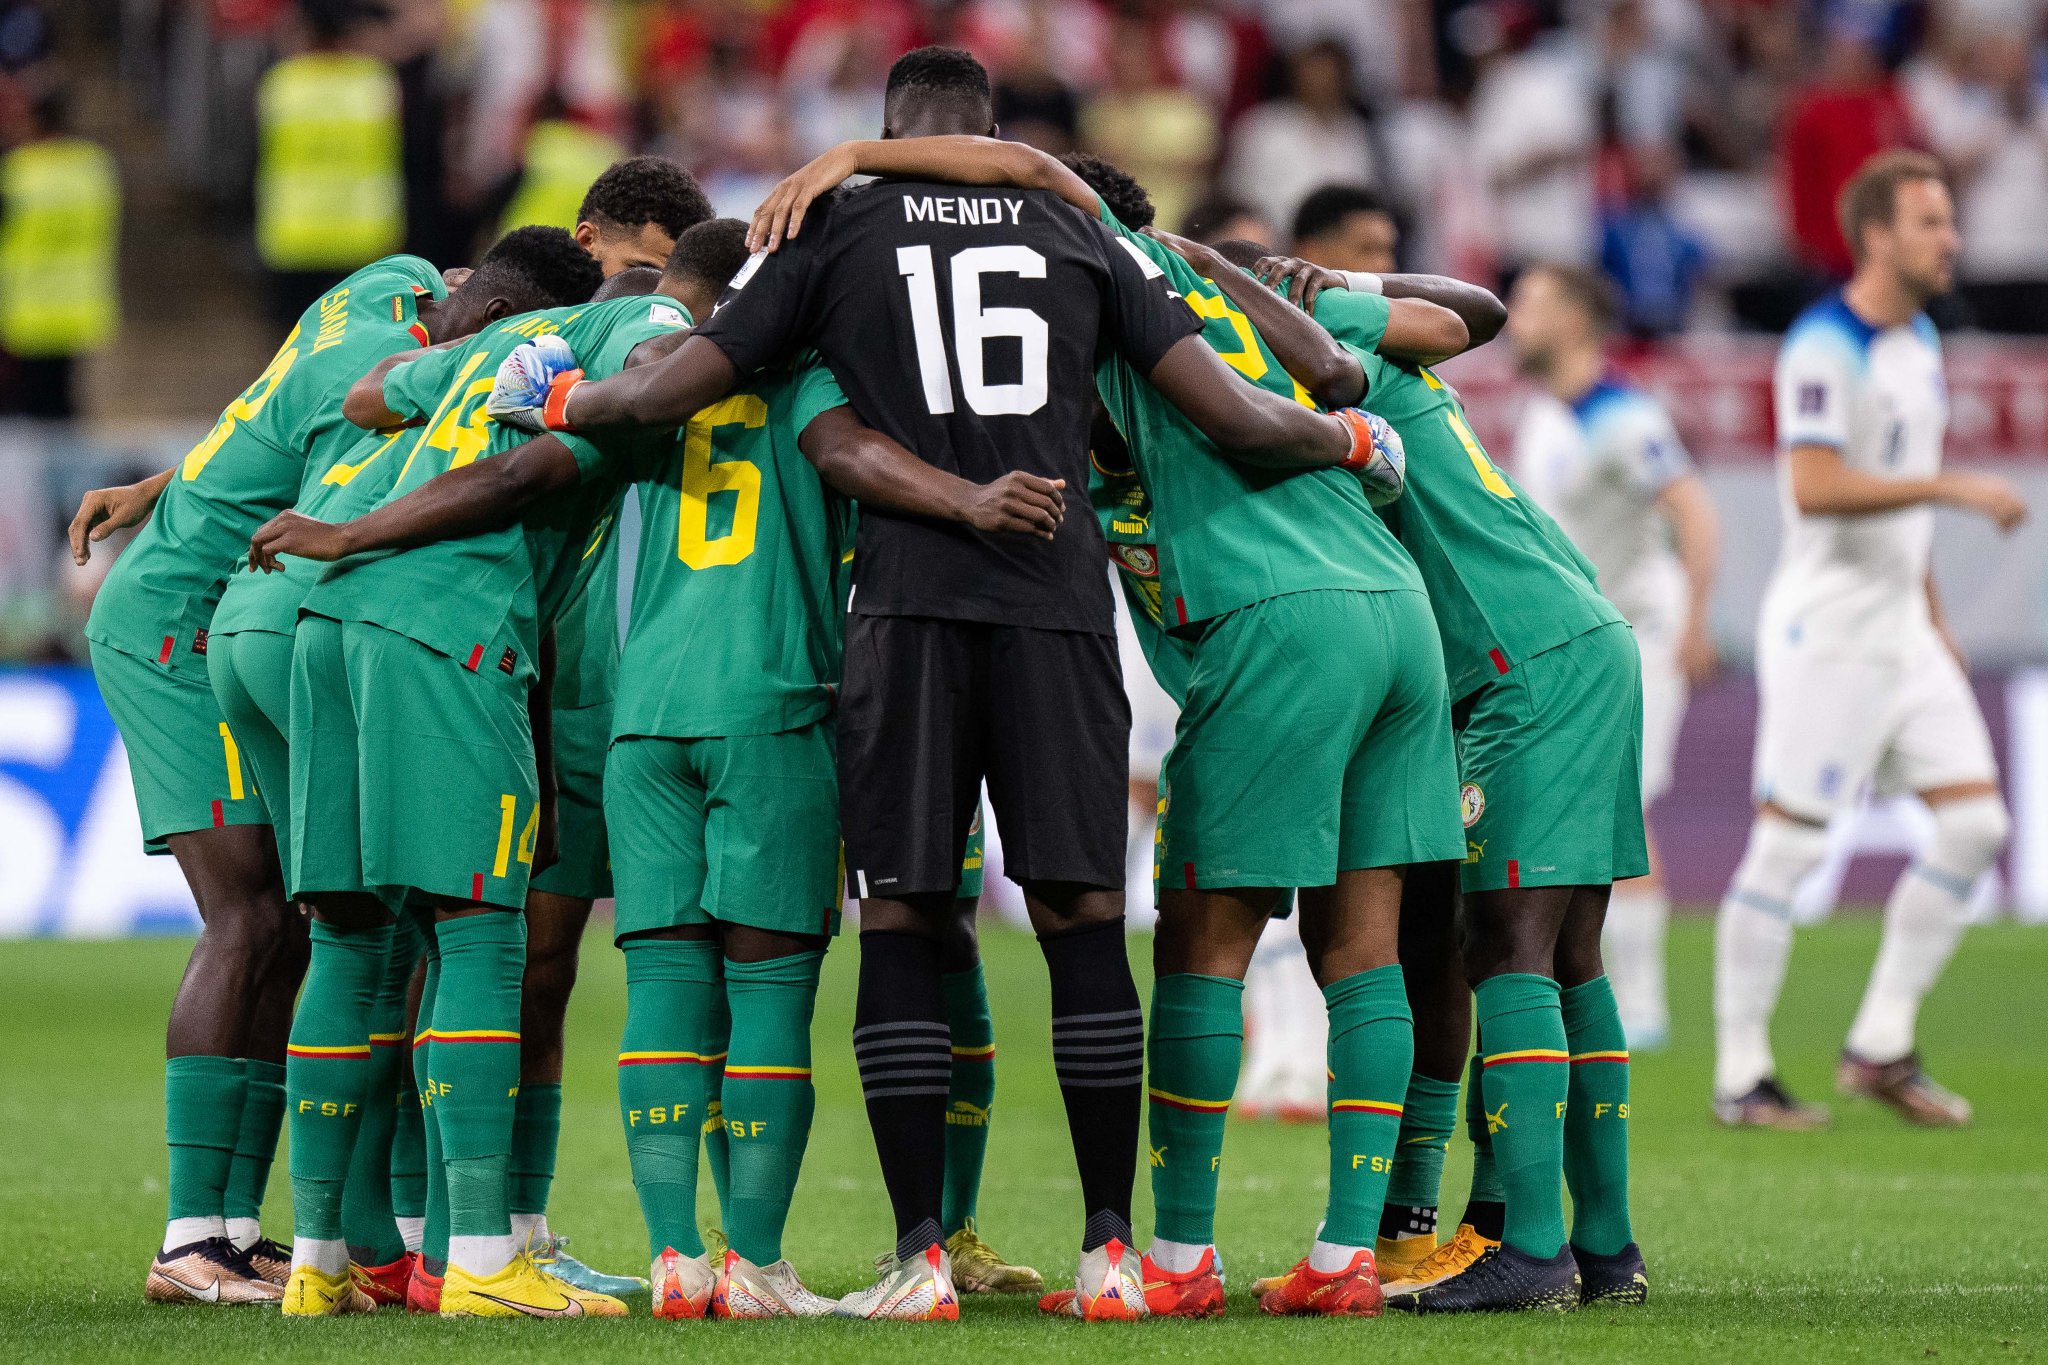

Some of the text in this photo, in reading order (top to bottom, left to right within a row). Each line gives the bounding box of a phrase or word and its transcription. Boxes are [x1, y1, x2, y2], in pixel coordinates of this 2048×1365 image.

[903, 195, 1024, 226] MENDY
[896, 244, 1049, 416] 16
[678, 394, 768, 571] 6
[1113, 519, 1143, 535] PUMA
[218, 722, 257, 800] 1
[492, 793, 541, 880] 14
[299, 1099, 358, 1118] FSF
[629, 1104, 690, 1128] FSF
[1594, 1102, 1630, 1120] FS
